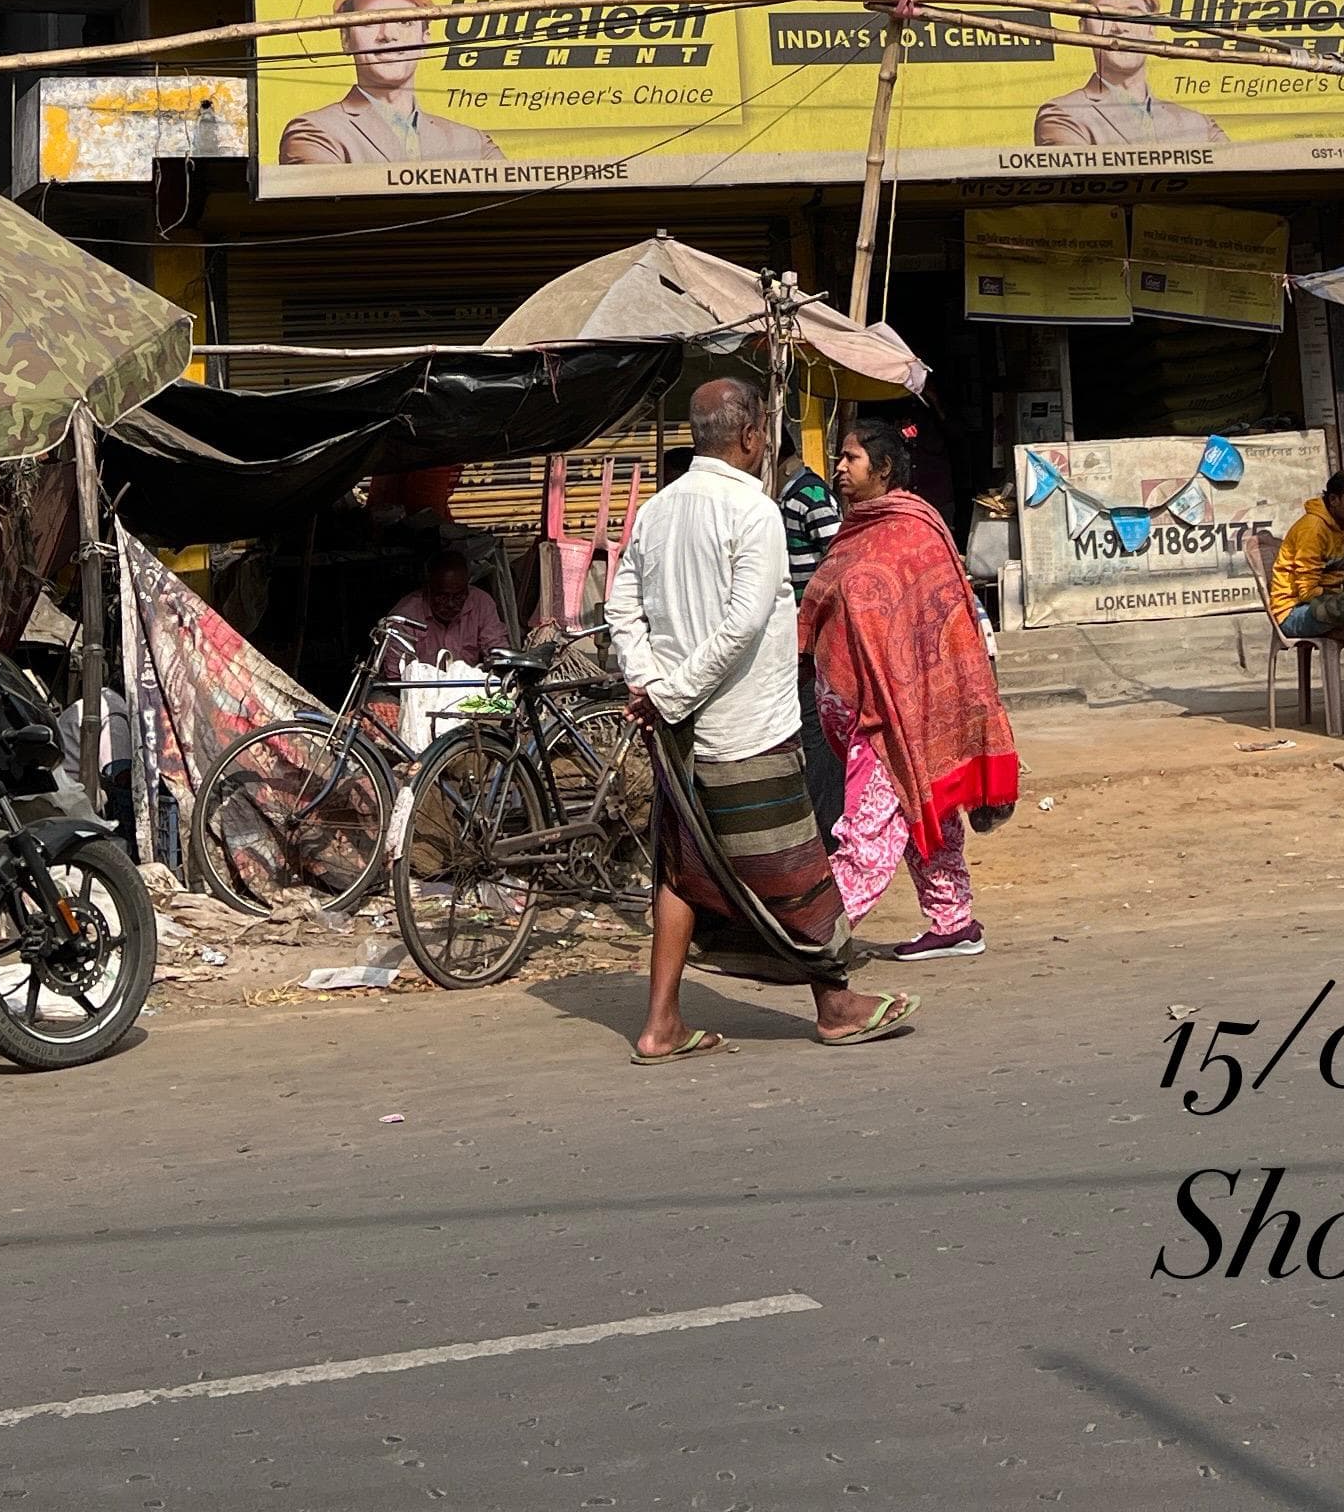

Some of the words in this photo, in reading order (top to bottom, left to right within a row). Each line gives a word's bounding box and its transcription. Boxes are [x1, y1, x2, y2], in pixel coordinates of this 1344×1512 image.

[778, 29, 871, 49] INDIA'S
[457, 46, 698, 67] CEMENT
[1174, 75, 1211, 94] The
[1221, 75, 1328, 97] Engineer's
[447, 88, 488, 107] The
[499, 86, 623, 110] Engineer's
[633, 85, 714, 104] Choice
[998, 151, 1098, 170] LOKENATH
[1103, 148, 1214, 168] ENTERPRISE
[386, 166, 498, 186] LOKENATH
[504, 163, 629, 183] ENTERPRISE
[1095, 591, 1177, 611] LOKENATH
